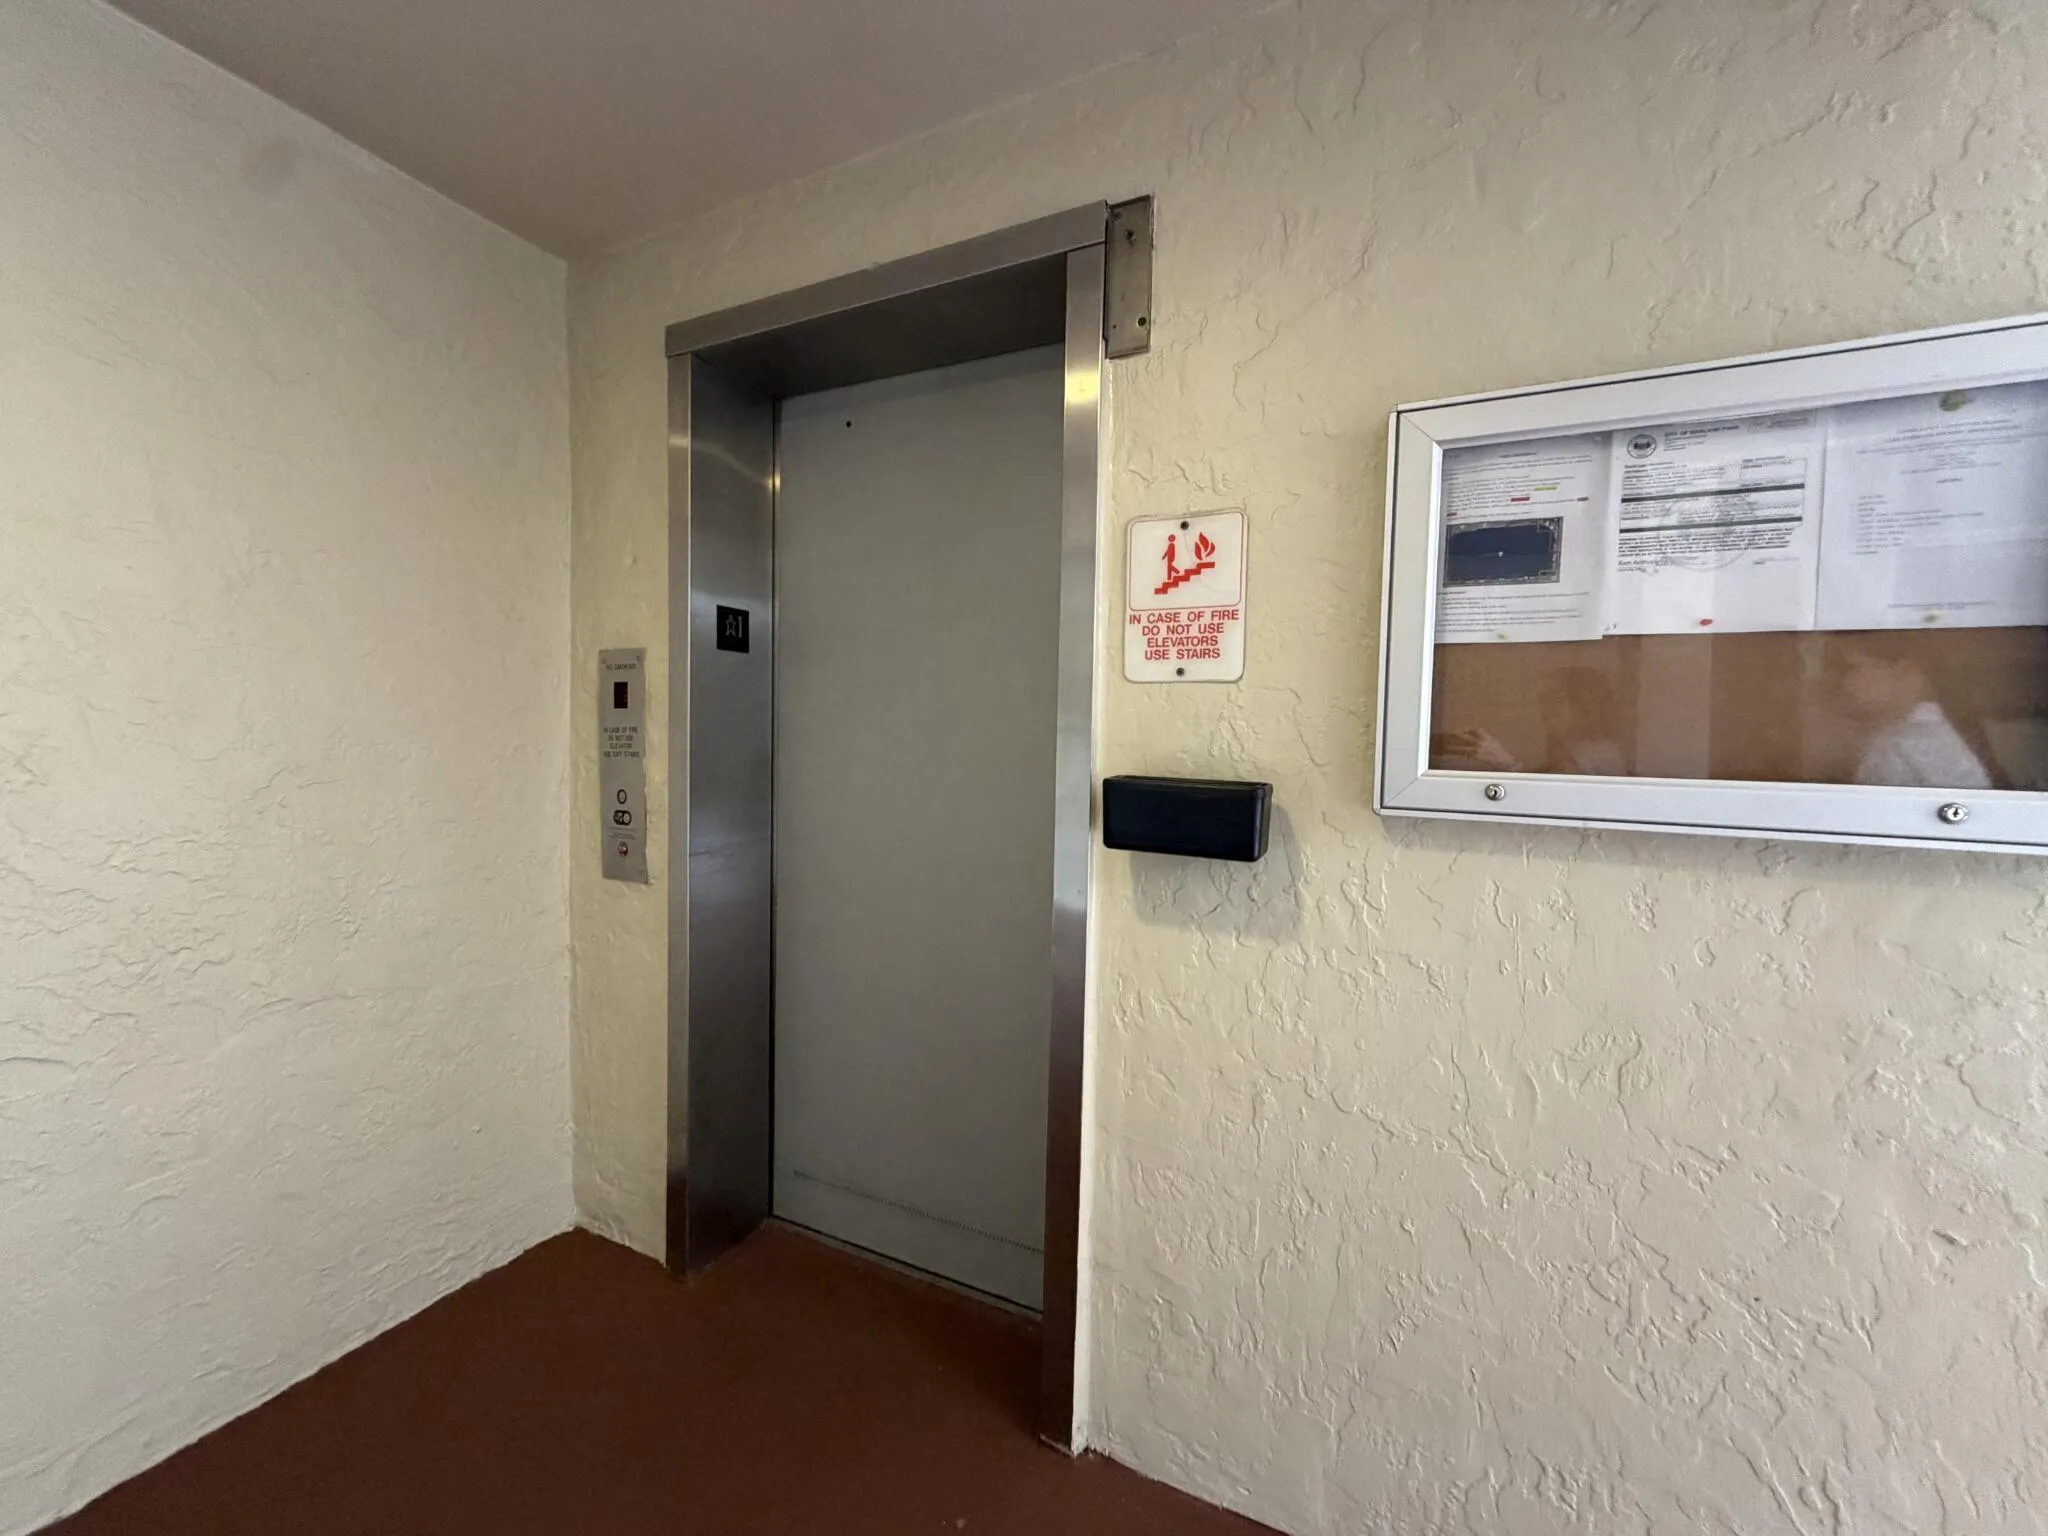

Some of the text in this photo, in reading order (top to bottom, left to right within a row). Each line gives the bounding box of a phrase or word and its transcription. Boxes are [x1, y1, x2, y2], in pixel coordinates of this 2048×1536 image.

[1129, 609, 1240, 625] IN CASE OF FIRE
[1142, 622, 1224, 636] DO NOT USE
[1147, 635, 1218, 648] ELEVATORS
[1145, 648, 1220, 660] USE STAIRS
